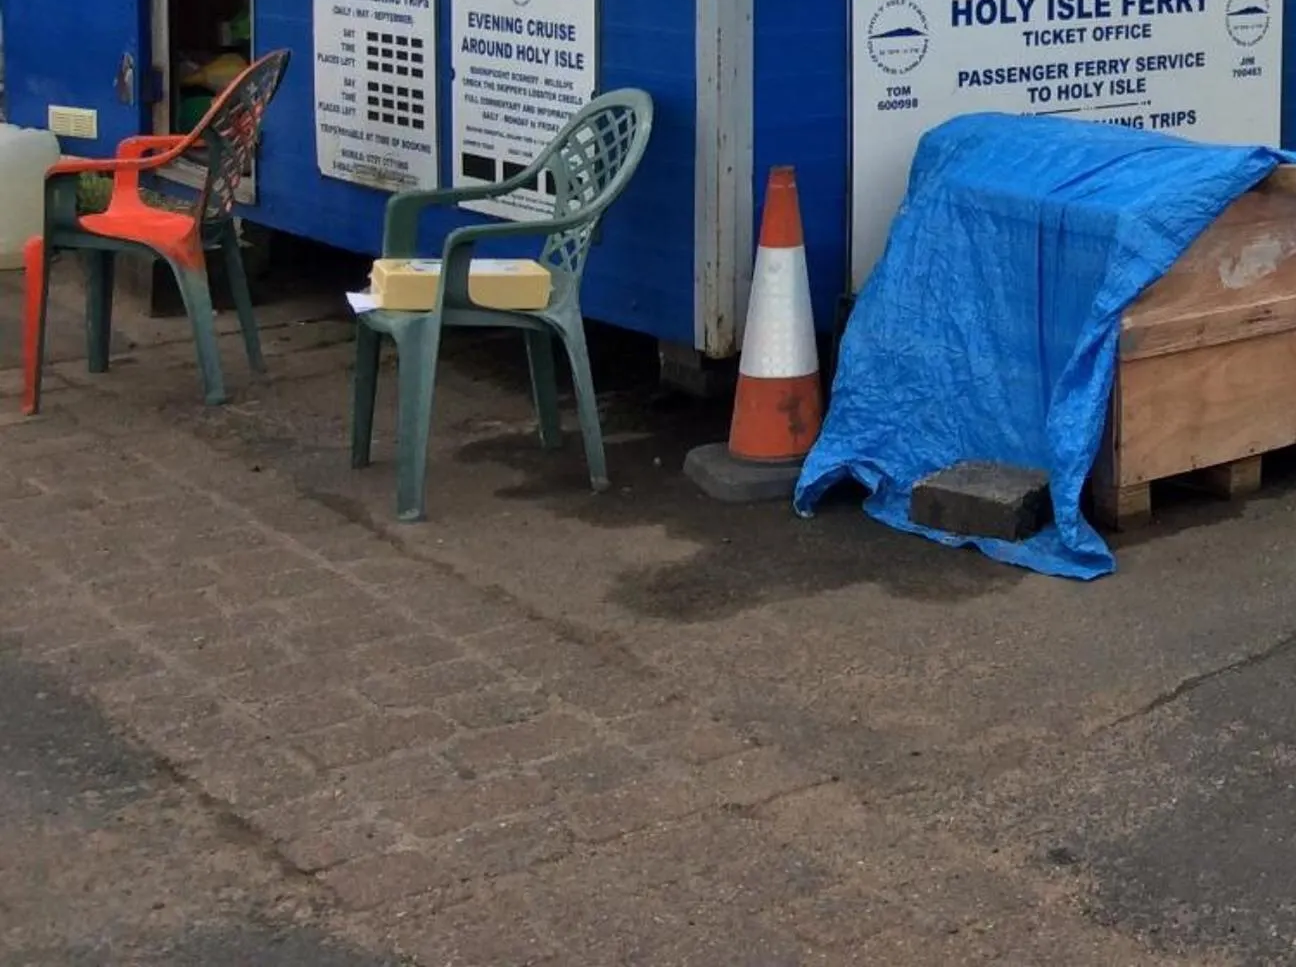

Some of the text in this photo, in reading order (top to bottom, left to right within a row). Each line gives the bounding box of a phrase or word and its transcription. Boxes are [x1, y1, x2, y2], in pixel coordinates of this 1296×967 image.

[468, 12, 576, 42] EVENING CRUISE
[1023, 23, 1152, 47] TICKET OFFICE
[461, 36, 584, 70] AROUND HOLY ISLE
[958, 52, 1205, 88] PASSENGER FERRY SERVICE
[886, 85, 911, 97] TOM
[1027, 78, 1146, 103] TO HOLY ISLE
[1150, 110, 1196, 129] TRIPS
